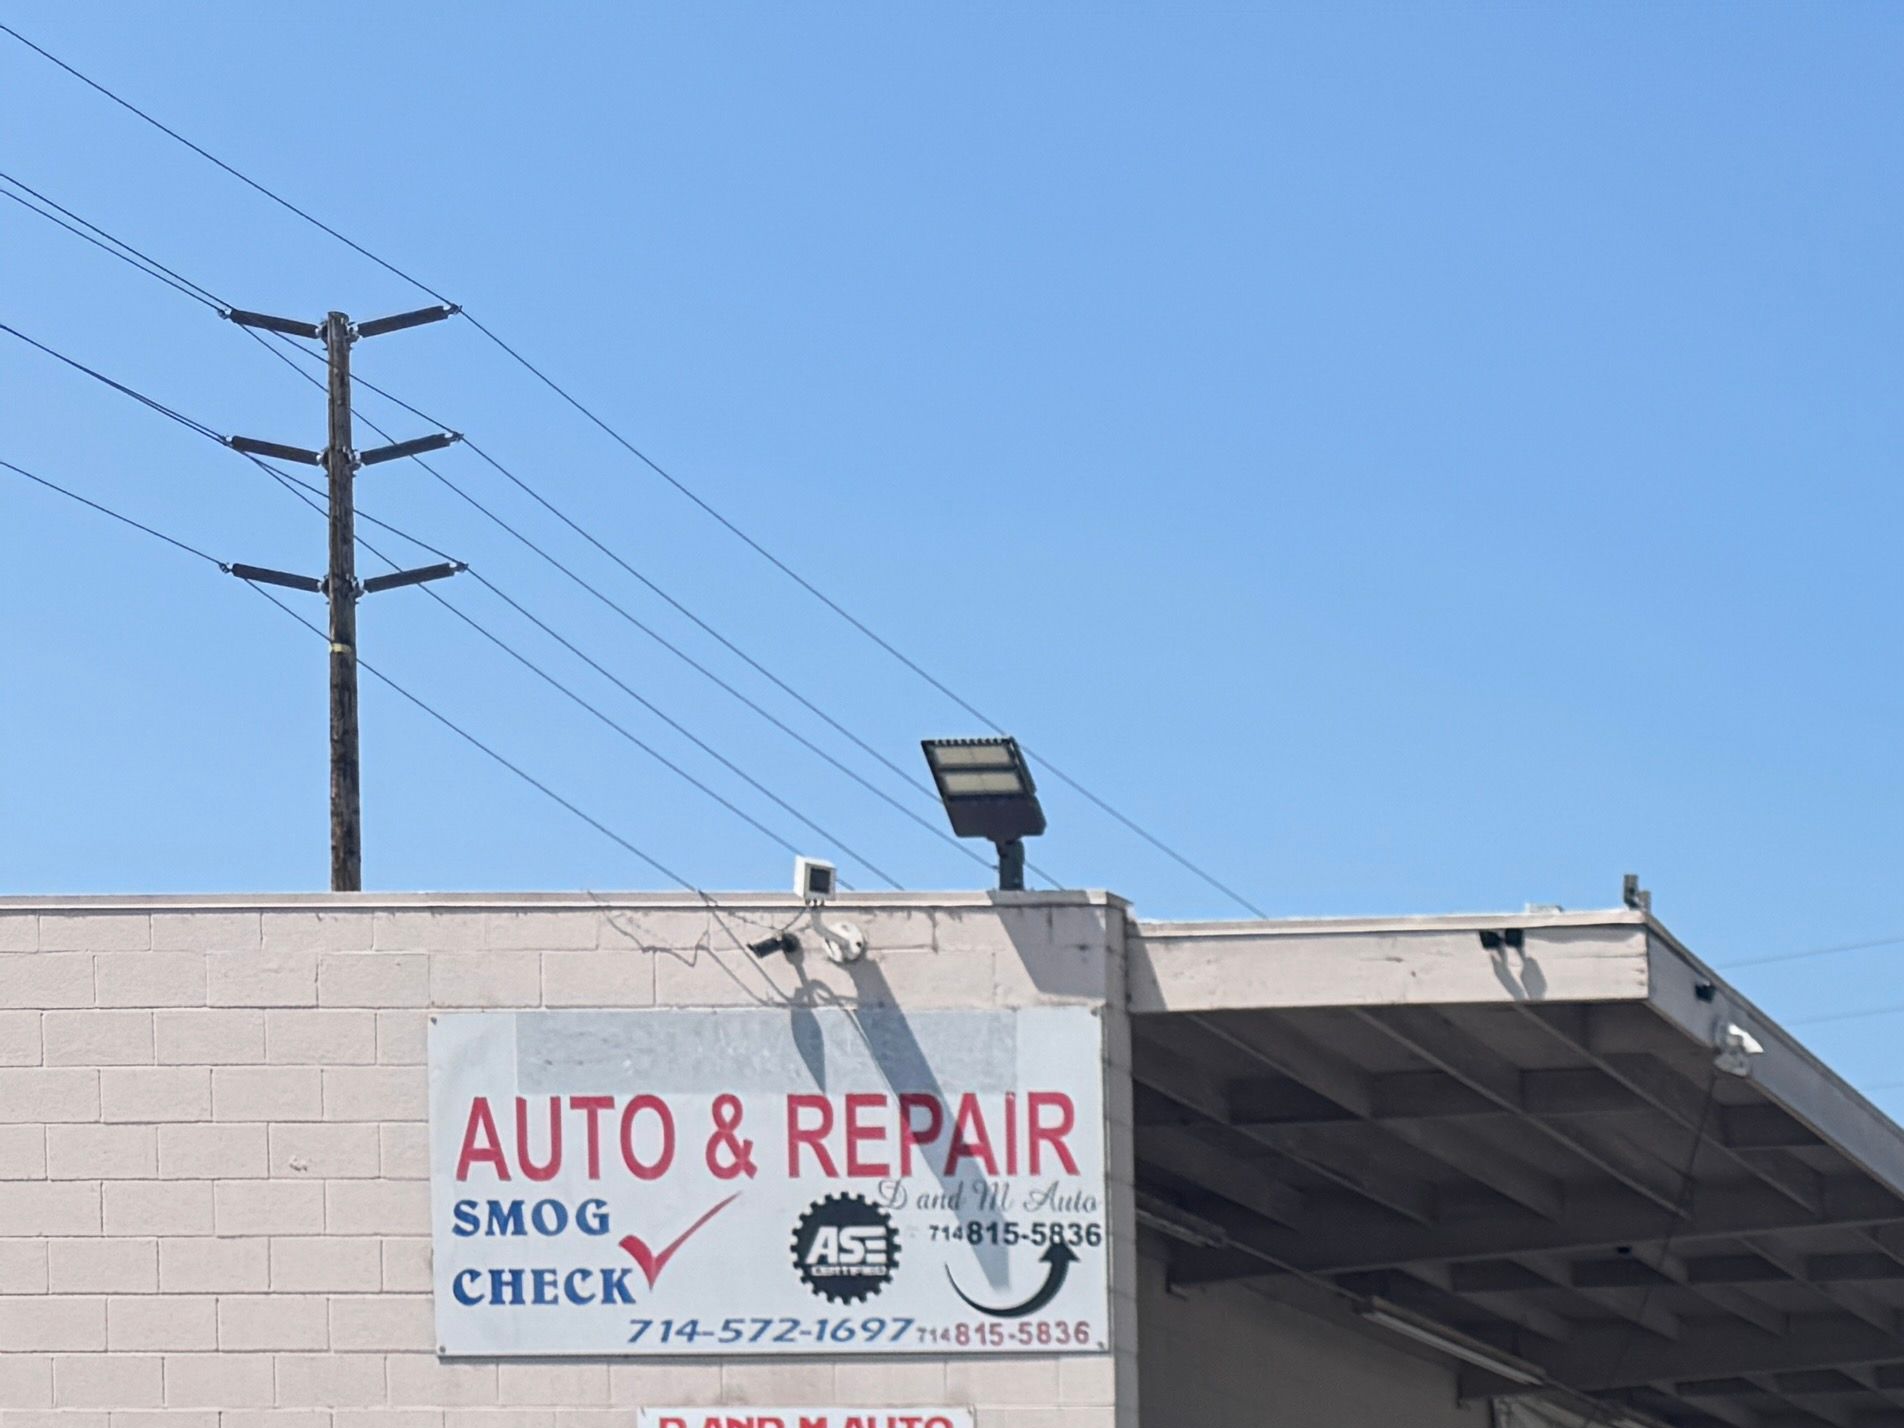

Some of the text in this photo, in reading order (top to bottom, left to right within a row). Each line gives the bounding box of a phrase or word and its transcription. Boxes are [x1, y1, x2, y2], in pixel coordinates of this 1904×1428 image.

[455, 1091, 1080, 1182] AUTO & REPAIR
[916, 1181, 962, 1211] and
[1022, 1180, 1098, 1212] Auto
[452, 1198, 611, 1237] SMOG
[805, 1226, 888, 1265] ASE
[452, 1267, 637, 1306] CHECK
[626, 1318, 915, 1345] 714-572-1697
